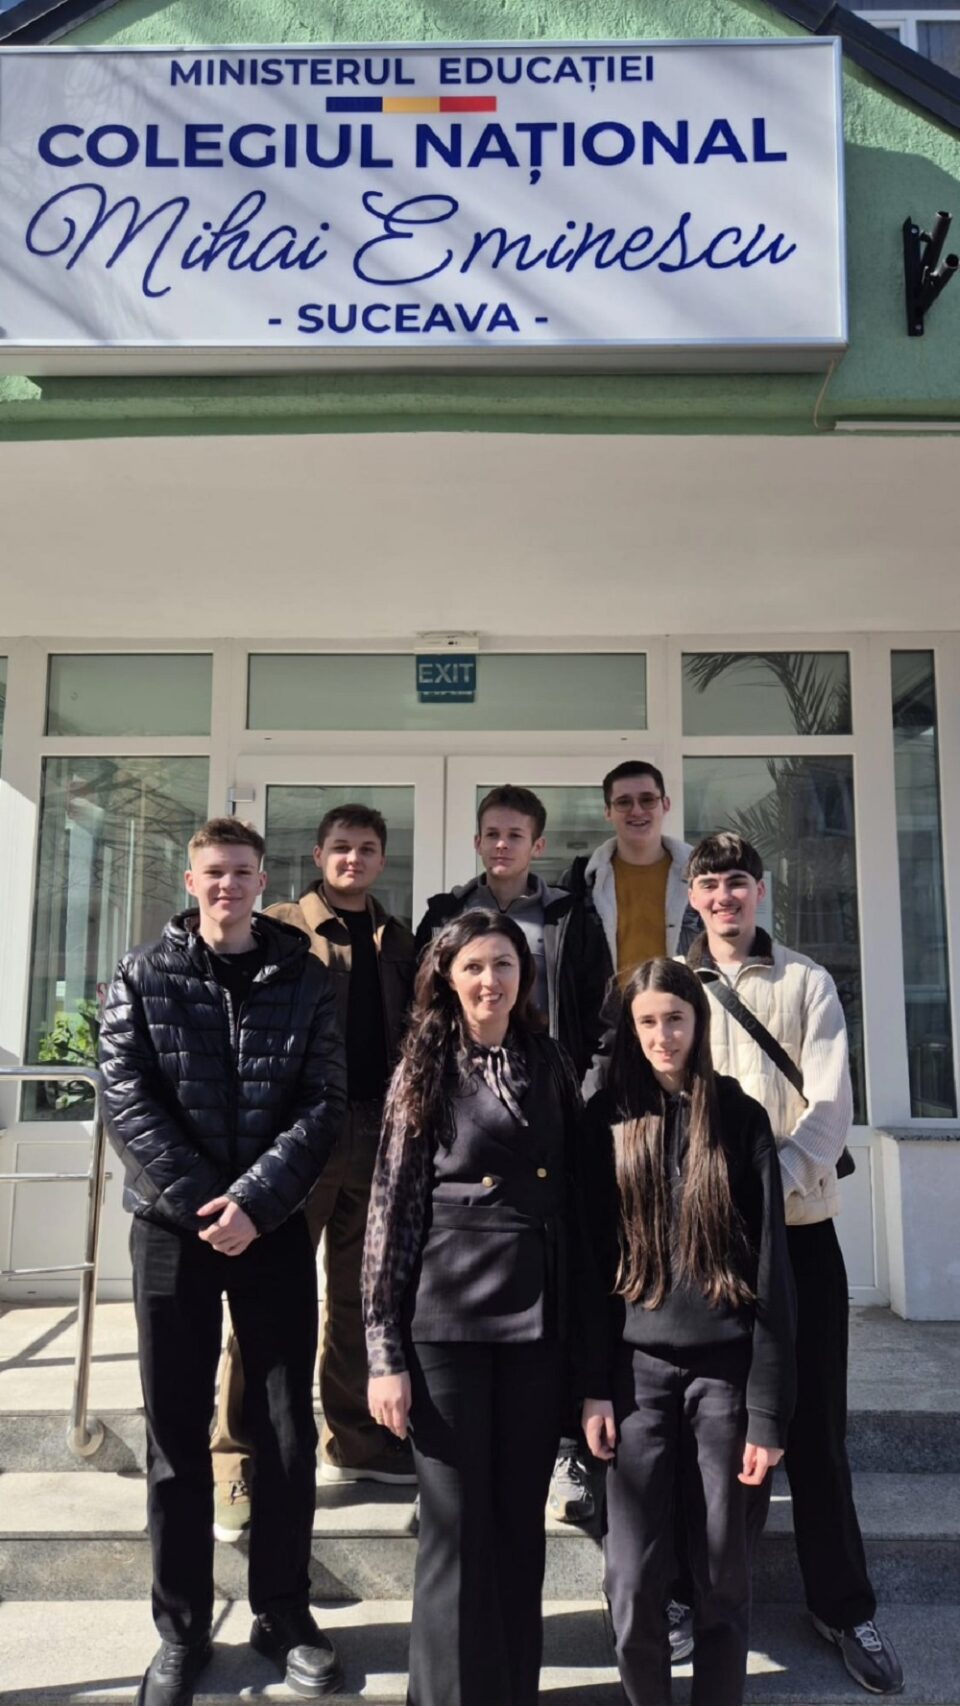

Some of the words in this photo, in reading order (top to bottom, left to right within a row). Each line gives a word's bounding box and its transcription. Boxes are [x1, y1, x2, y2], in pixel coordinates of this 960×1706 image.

[170, 56, 416, 87] MINISTERUL
[439, 54, 655, 93] EDUCAȚIEI
[37, 122, 394, 169] COLEGIUL
[415, 117, 788, 186] NAȚIONAL
[25, 182, 330, 298] Mihai
[352, 190, 797, 286] Eminescu
[297, 302, 520, 334] SUCEAVA
[418, 663, 475, 684] EXIT
